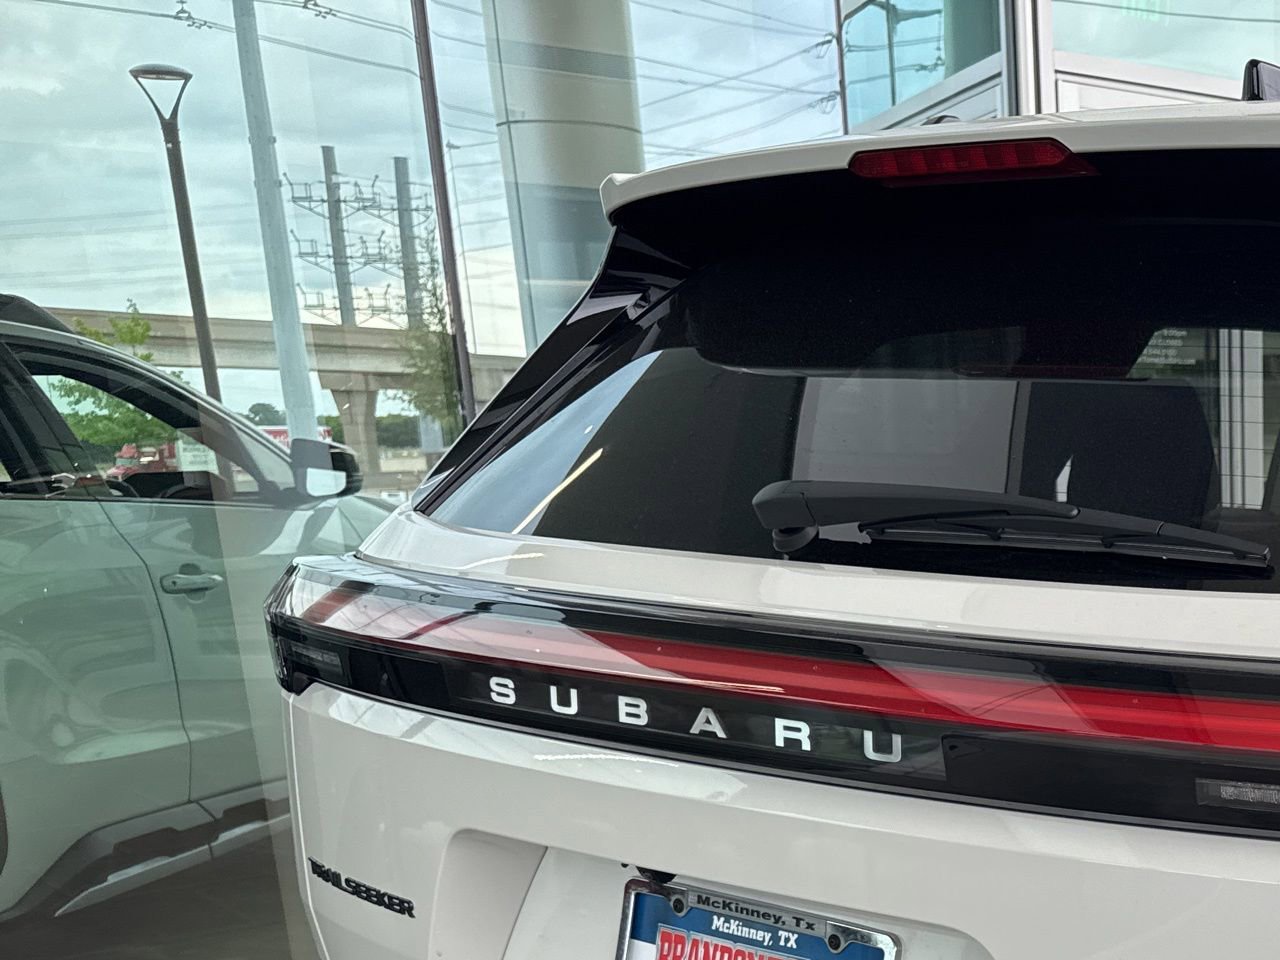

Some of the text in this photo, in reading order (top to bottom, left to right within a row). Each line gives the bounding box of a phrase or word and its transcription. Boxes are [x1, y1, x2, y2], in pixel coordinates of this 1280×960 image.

[490, 677, 901, 763] SUBARU
[697, 895, 816, 931] McKinney, Tx
[711, 915, 798, 949] McKinney, TX
